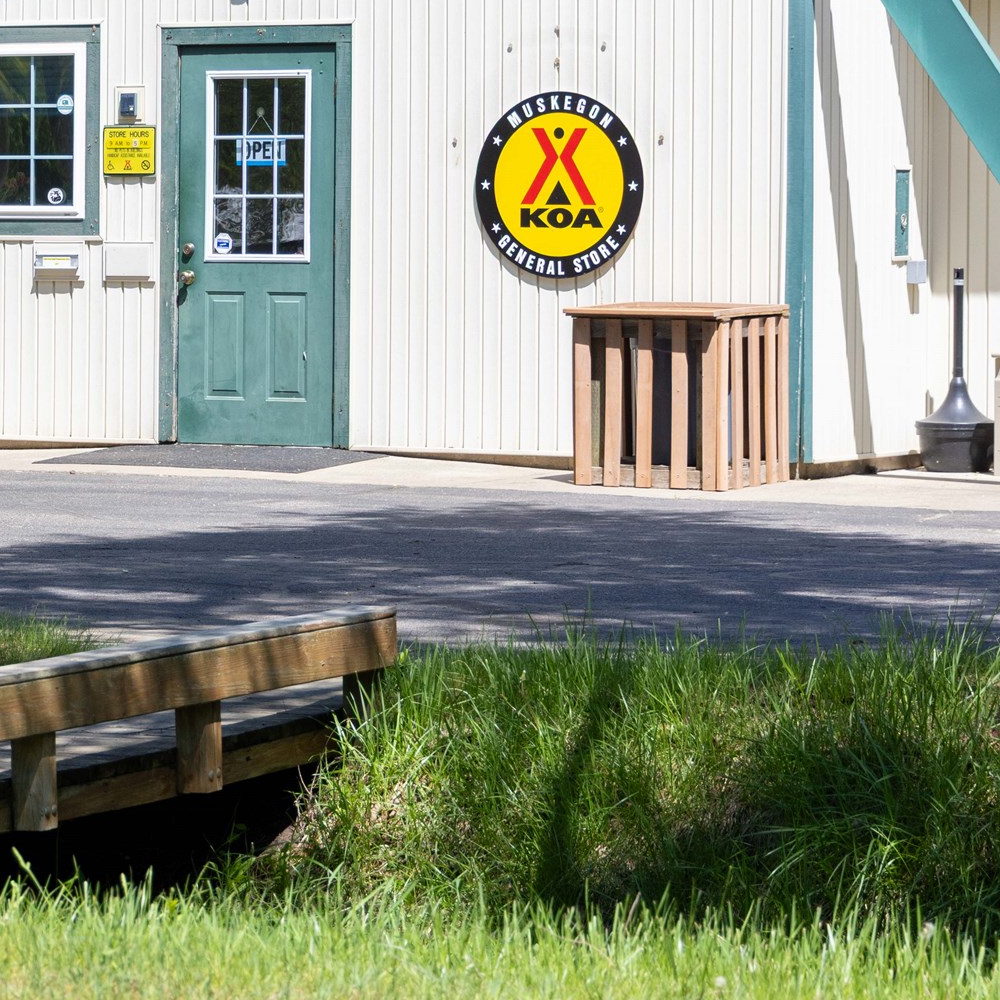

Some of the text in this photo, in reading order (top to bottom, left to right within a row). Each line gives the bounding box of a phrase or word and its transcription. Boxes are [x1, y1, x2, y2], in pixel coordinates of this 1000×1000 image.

[506, 95, 613, 129] MUSKEGON
[520, 207, 603, 229] KOA
[498, 234, 620, 276] GENERAL STORE
